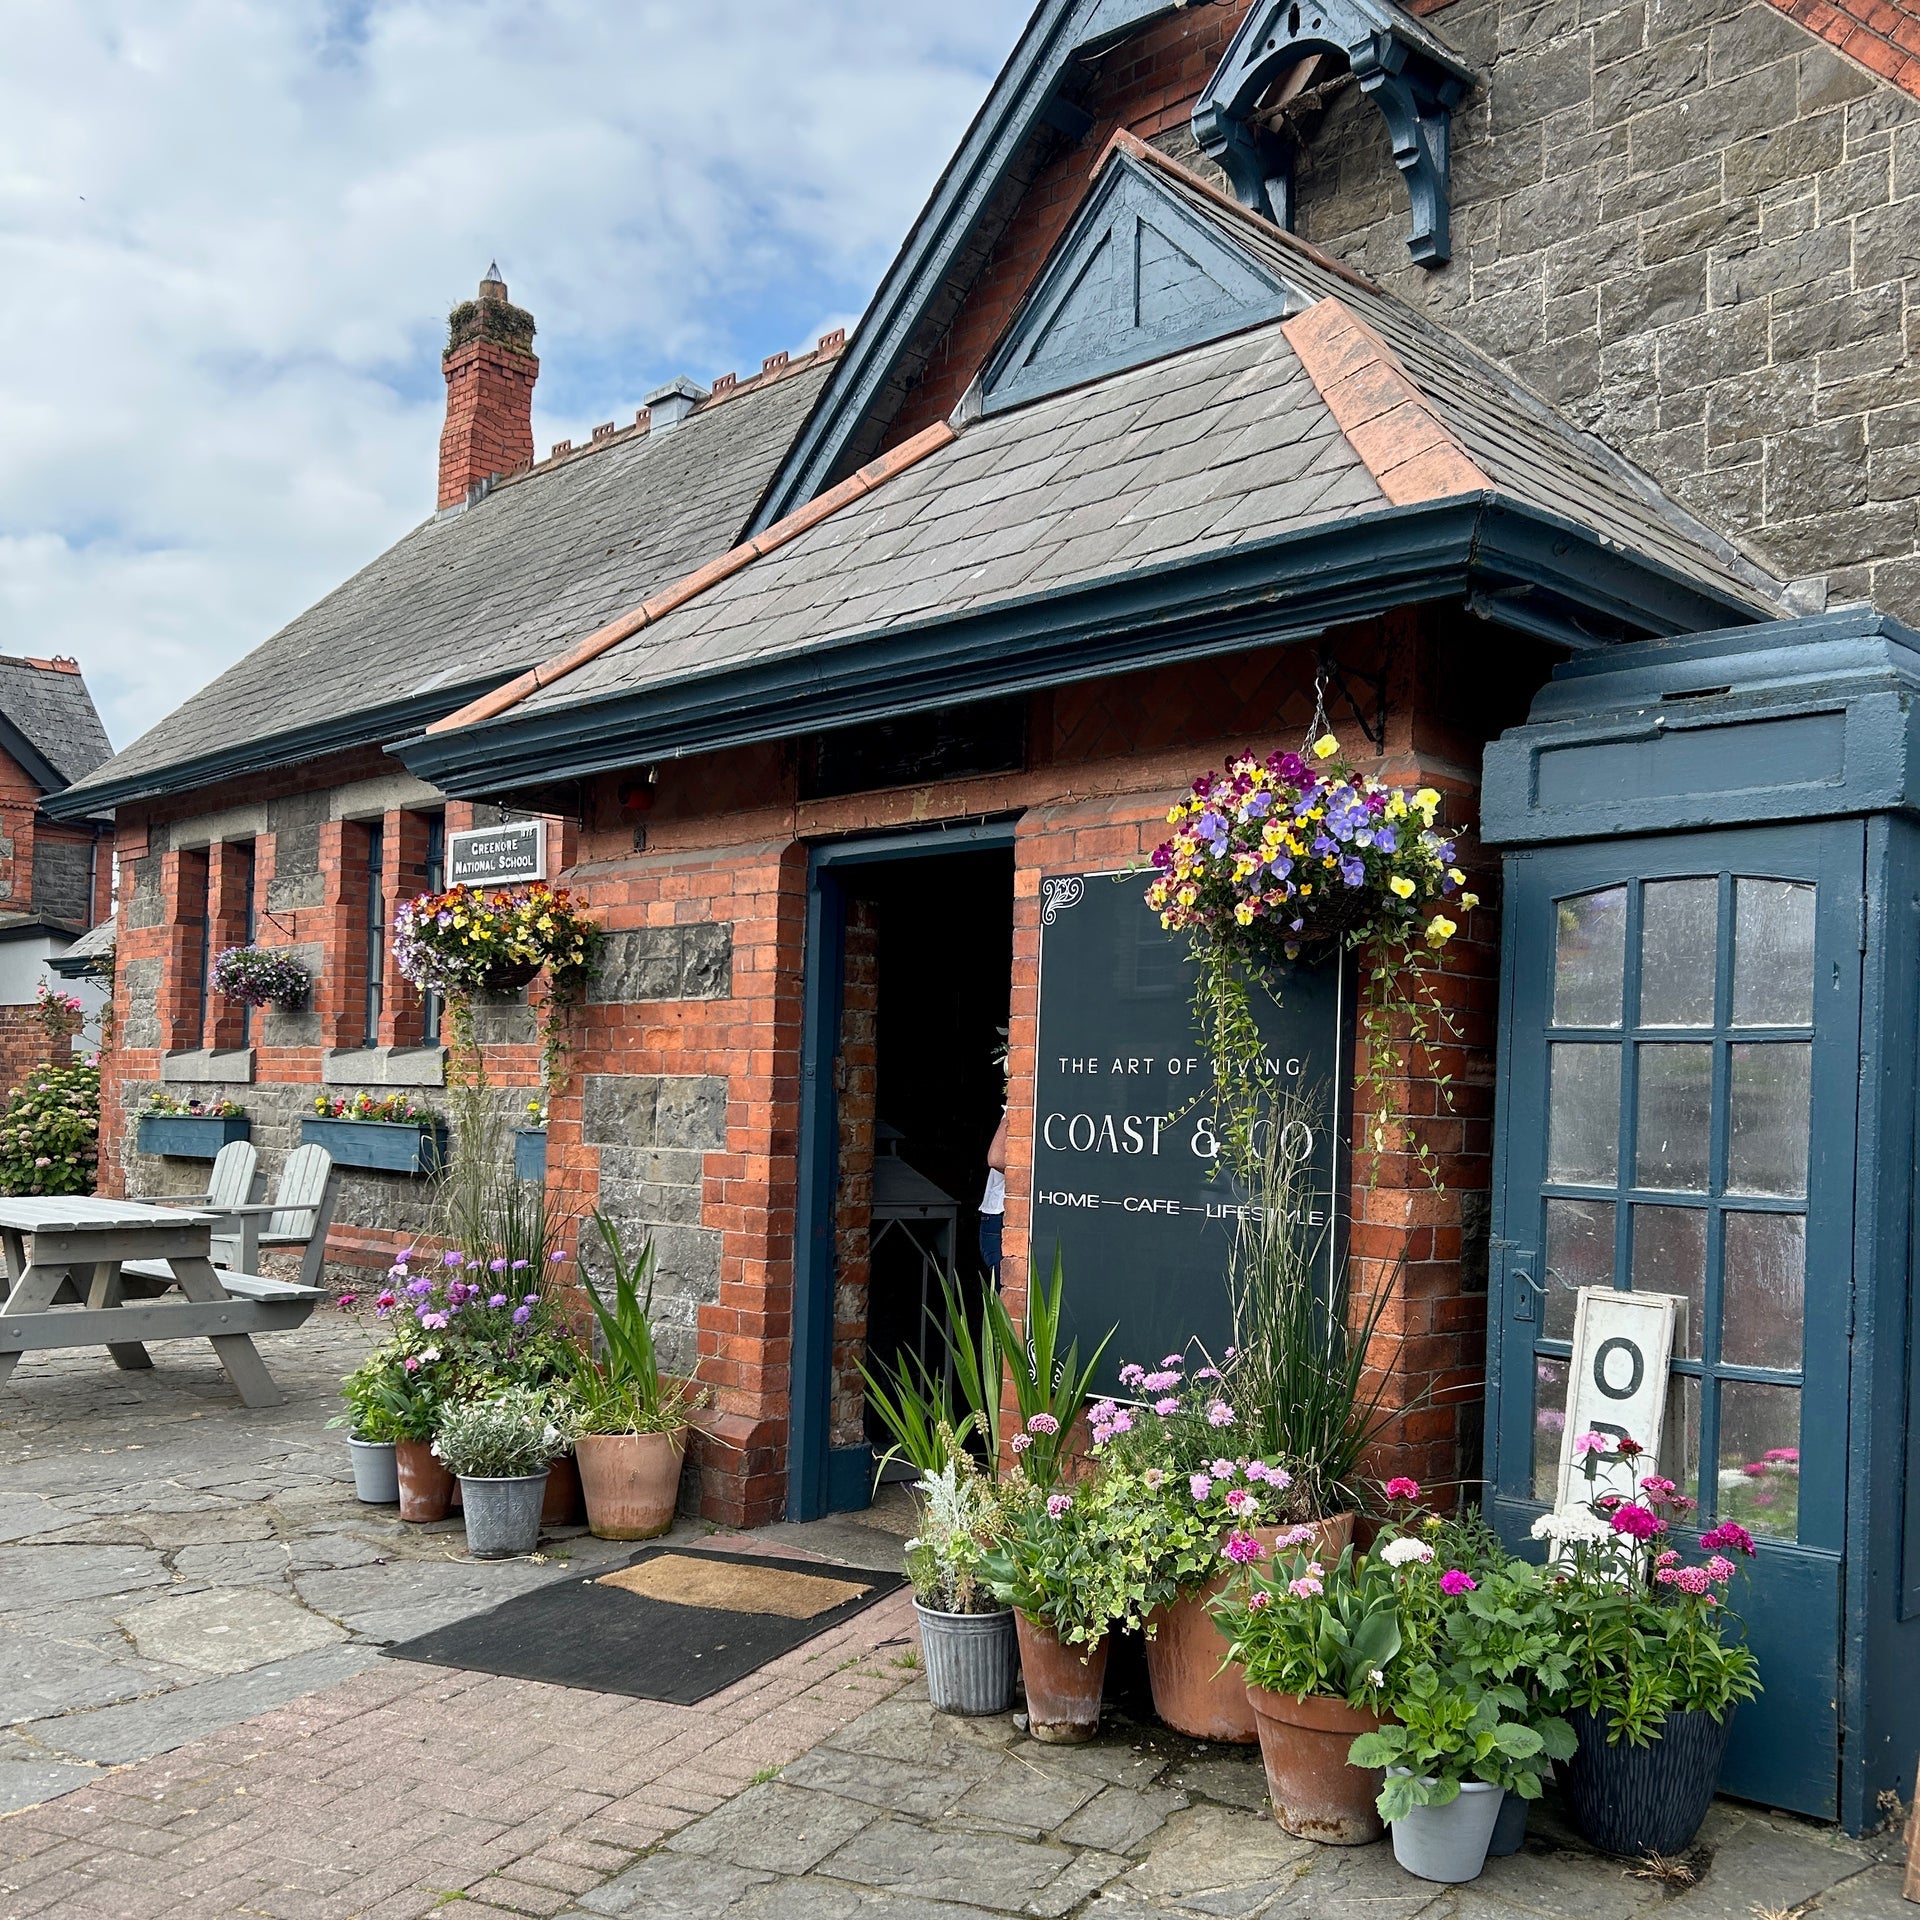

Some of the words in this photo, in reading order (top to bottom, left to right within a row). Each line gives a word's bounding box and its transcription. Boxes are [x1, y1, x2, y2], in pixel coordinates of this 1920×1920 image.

[455, 860, 496, 874] NATIONAL
[499, 855, 534, 869] SCHOOL
[1058, 1058, 1098, 1074] THE
[1111, 1058, 1154, 1074] ART
[1168, 1058, 1198, 1075] OF
[1043, 1112, 1168, 1155] COAST
[1191, 1117, 1220, 1158] &
